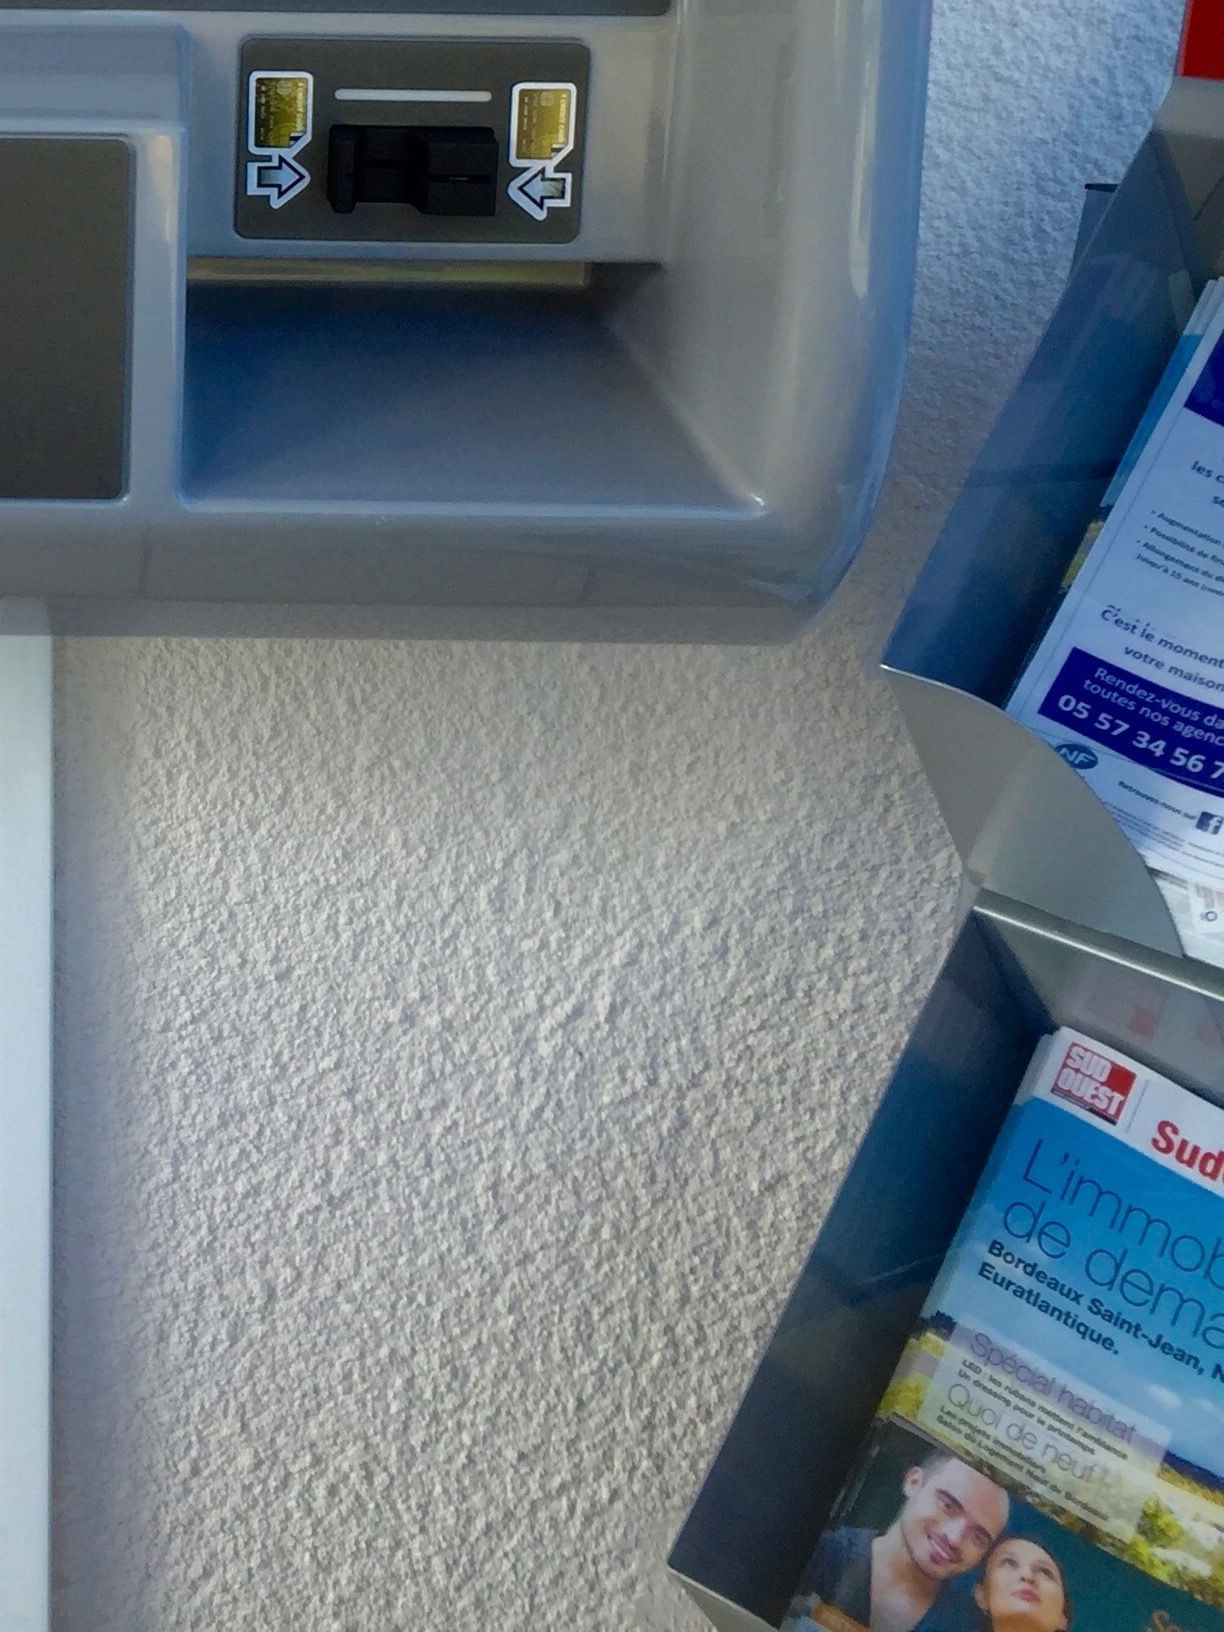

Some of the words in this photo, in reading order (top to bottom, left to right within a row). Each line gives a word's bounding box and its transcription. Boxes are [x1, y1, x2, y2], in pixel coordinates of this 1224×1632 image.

[1191, 460, 1214, 478] les
[1124, 646, 1165, 670] votre
[1168, 665, 1224, 693] maison
[1140, 626, 1155, 642] le
[1157, 637, 1224, 669] moment
[1083, 679, 1137, 711] toutes
[1139, 706, 1170, 727] nos
[1094, 668, 1201, 722] Rendez-vous
[1058, 695, 1092, 719] 05
[1094, 713, 1130, 736] 57
[1132, 731, 1167, 758] 34
[1169, 747, 1206, 773] 56
[1059, 747, 1095, 765] NF
[1065, 1045, 1113, 1082] SUD
[1057, 1067, 1125, 1115] OUEST
[1151, 1120, 1224, 1185] Sud
[1003, 1201, 1071, 1258] de
[977, 1261, 1119, 1355] Euratlantique.
[988, 1239, 1084, 1305] Bordeaux
[1087, 1297, 1204, 1376] Saint-Jean,
[970, 1332, 1057, 1396] Spécial
[1058, 1383, 1137, 1443] habitat
[948, 1383, 1001, 1428] Quoi
[1005, 1417, 1038, 1450] de
